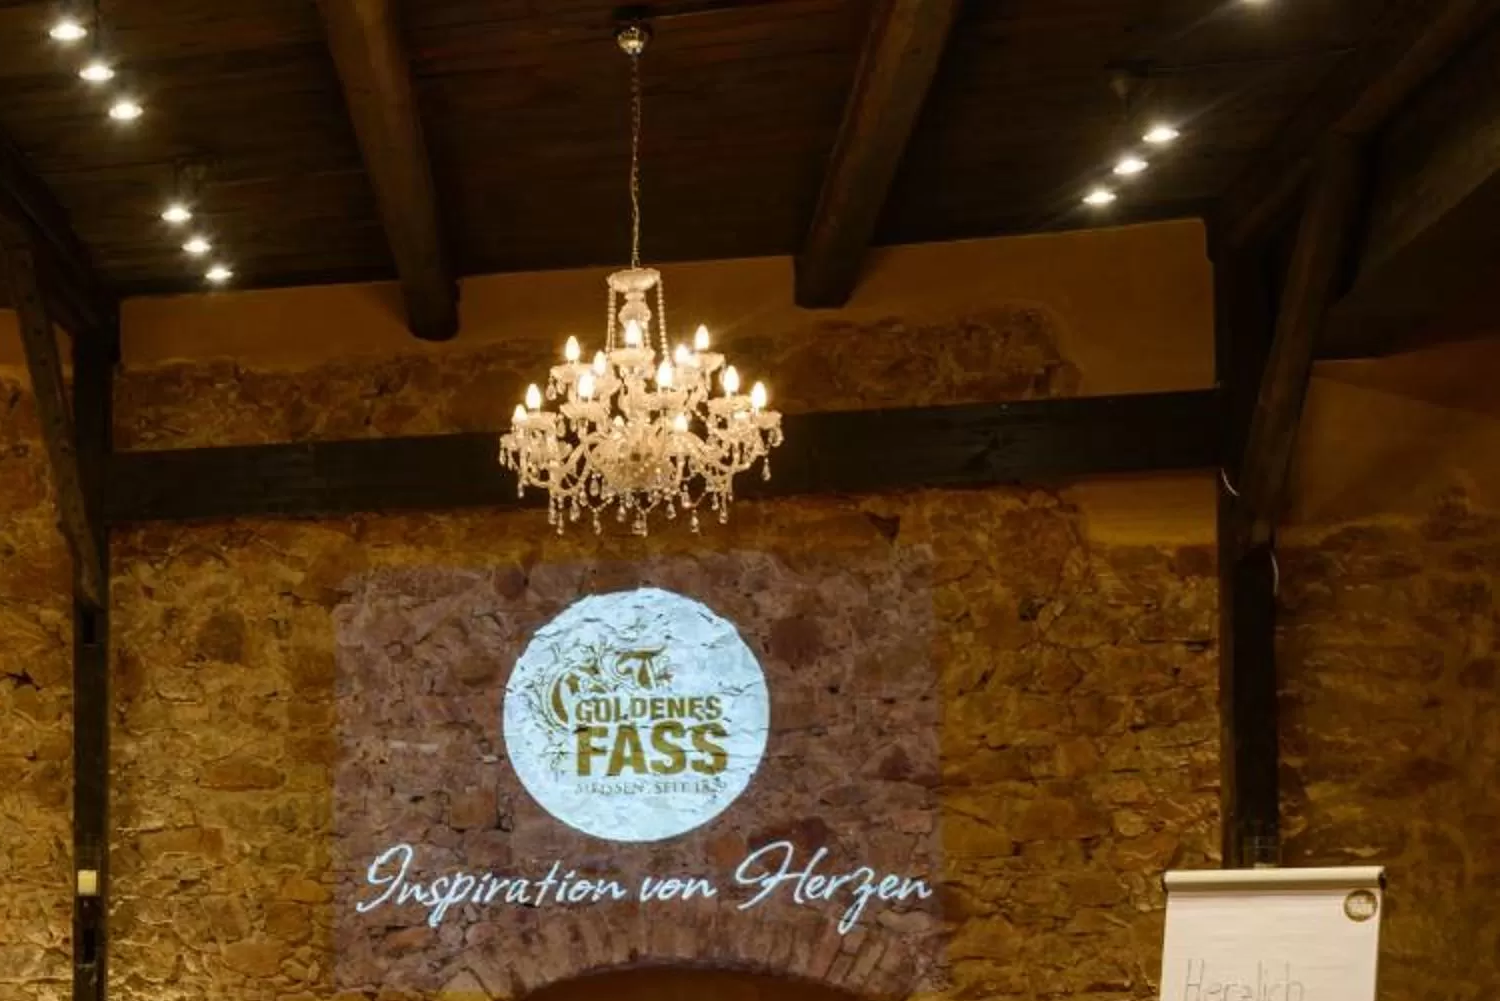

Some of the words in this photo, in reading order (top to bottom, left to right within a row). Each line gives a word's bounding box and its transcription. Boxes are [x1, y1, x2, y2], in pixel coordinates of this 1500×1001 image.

[575, 696, 723, 722] GOLDENES
[574, 721, 729, 776] FASS
[356, 843, 628, 928] Inspiration
[639, 875, 717, 902] von
[734, 840, 933, 935] Herzen
